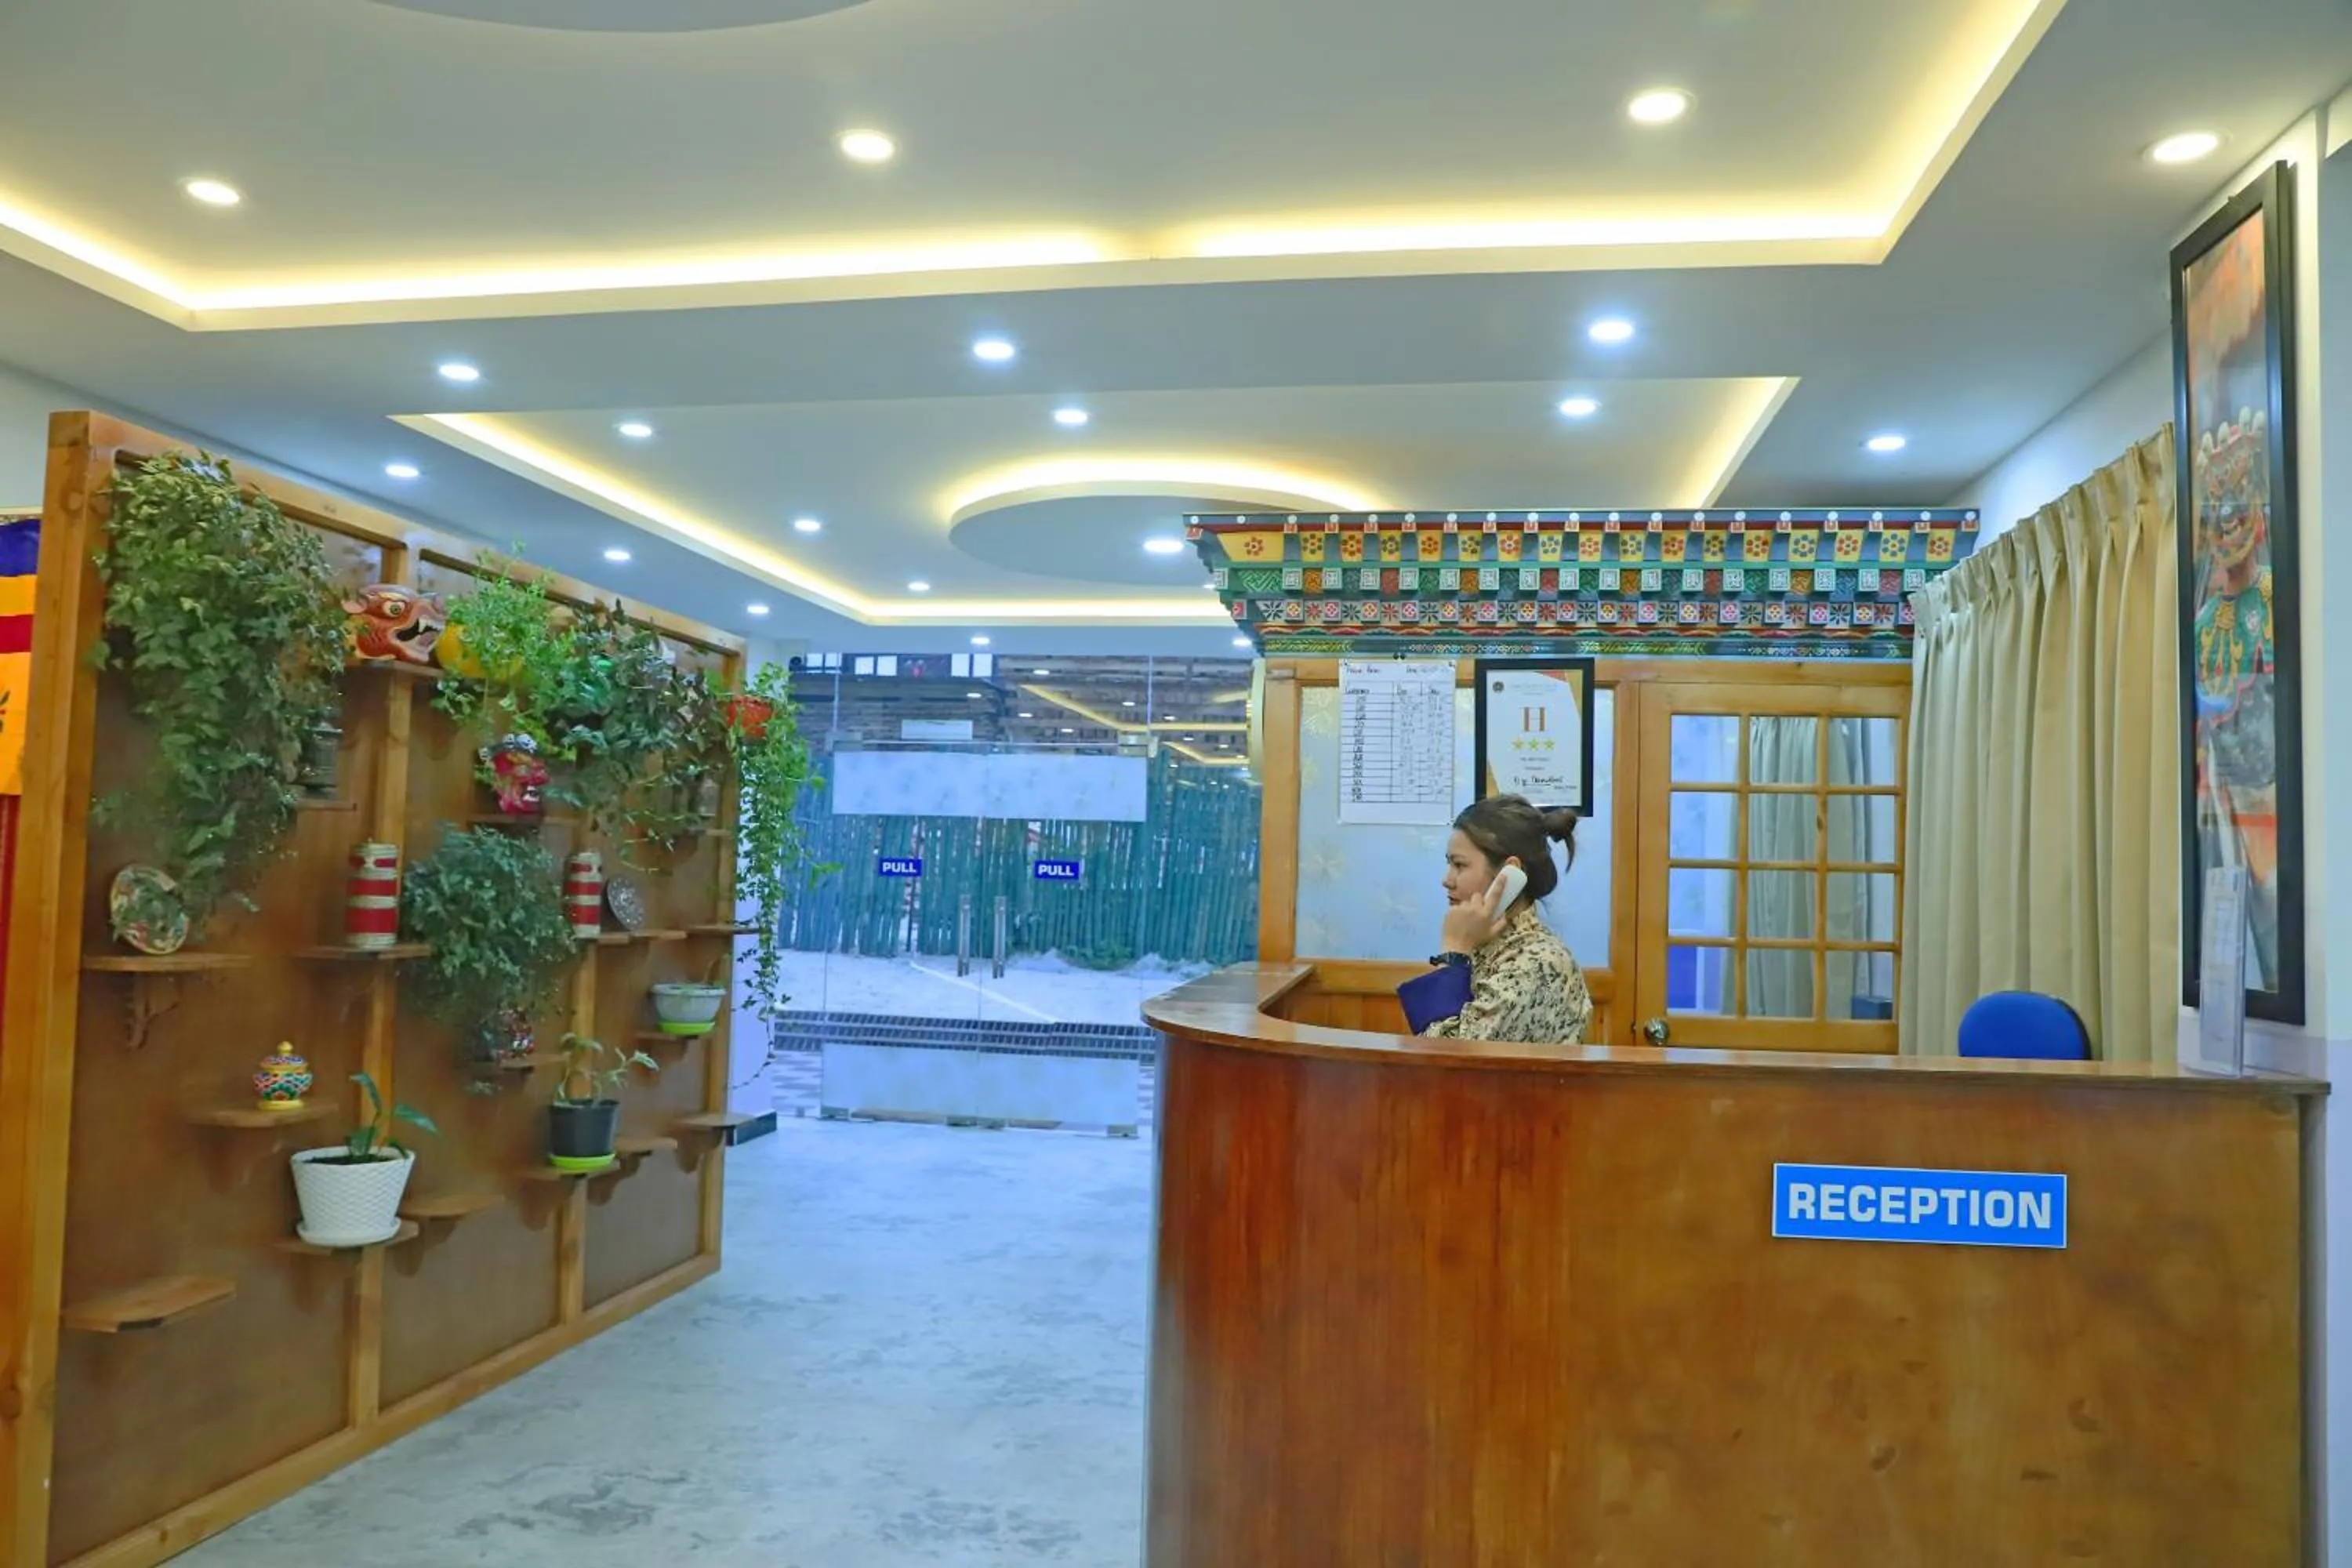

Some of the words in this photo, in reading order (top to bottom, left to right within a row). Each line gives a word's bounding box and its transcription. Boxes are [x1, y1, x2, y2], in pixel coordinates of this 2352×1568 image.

[882, 862, 916, 873] PULL
[1038, 864, 1075, 876] PULL
[1788, 1182, 2051, 1229] RECEPTION
